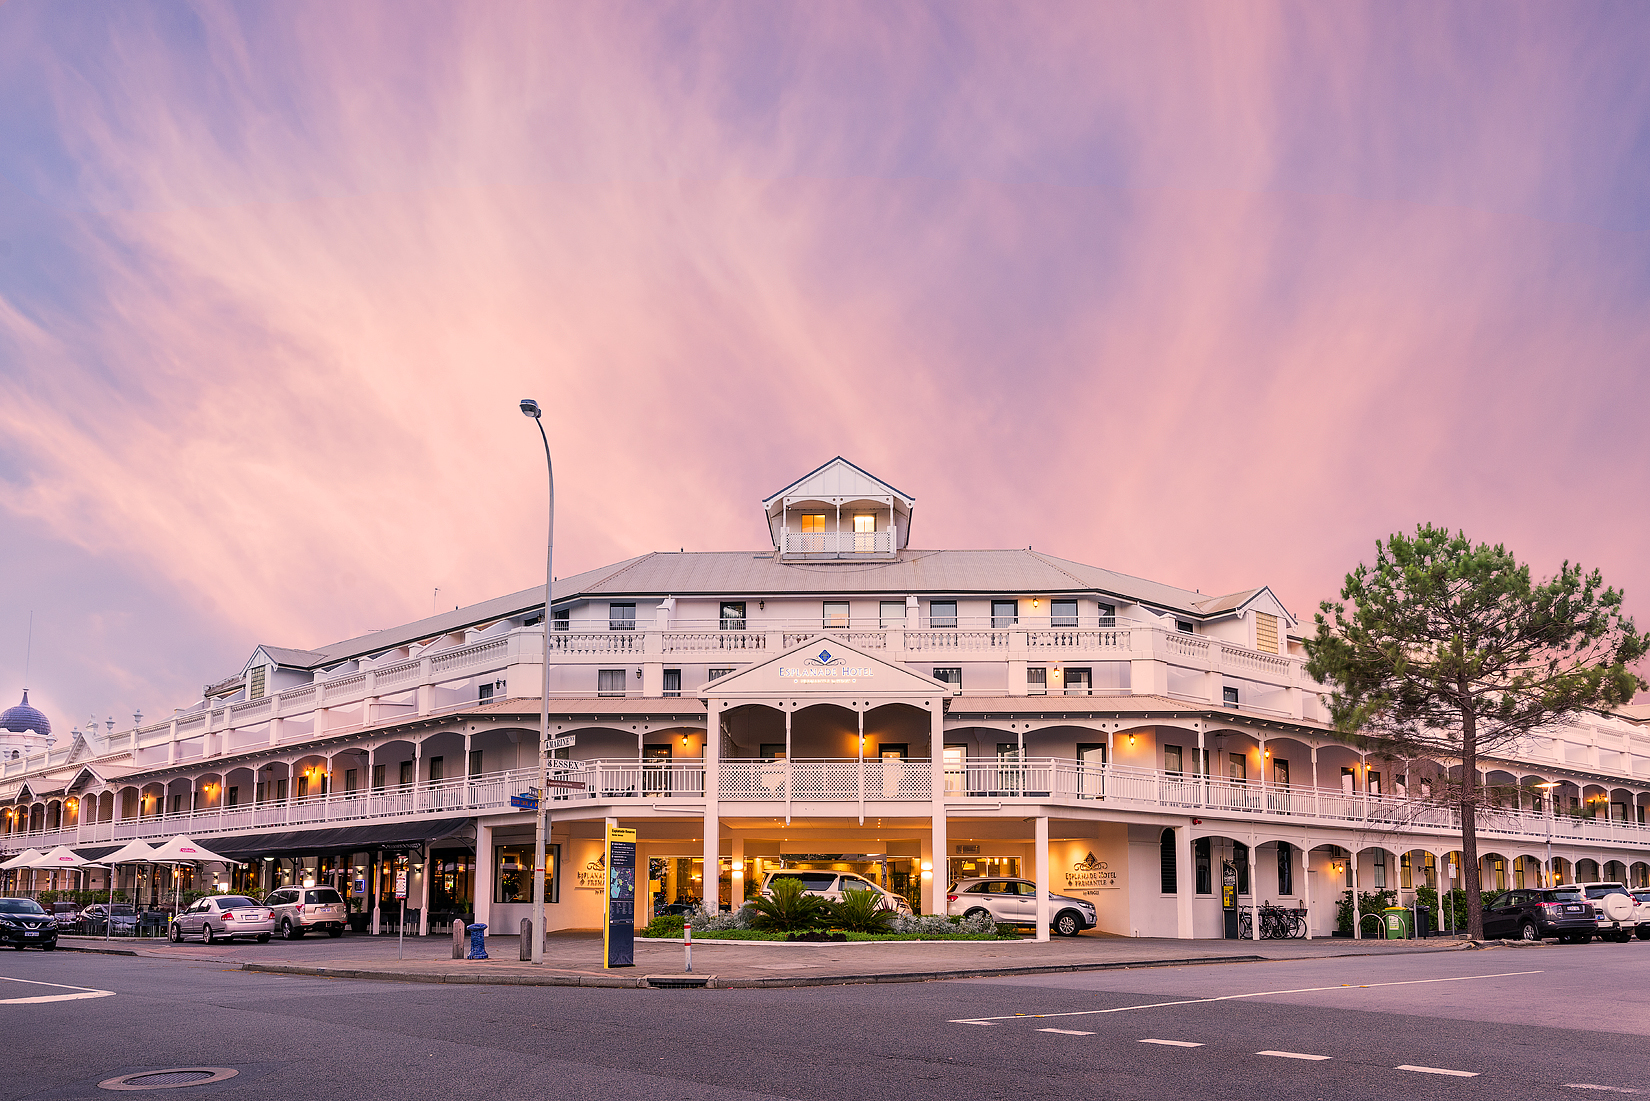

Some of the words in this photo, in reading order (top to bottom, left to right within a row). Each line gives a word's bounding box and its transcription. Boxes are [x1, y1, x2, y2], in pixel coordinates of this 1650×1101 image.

[779, 667, 837, 677] ESPLANADE
[842, 667, 874, 676] HOTEL
[553, 760, 579, 770] ESSEX
